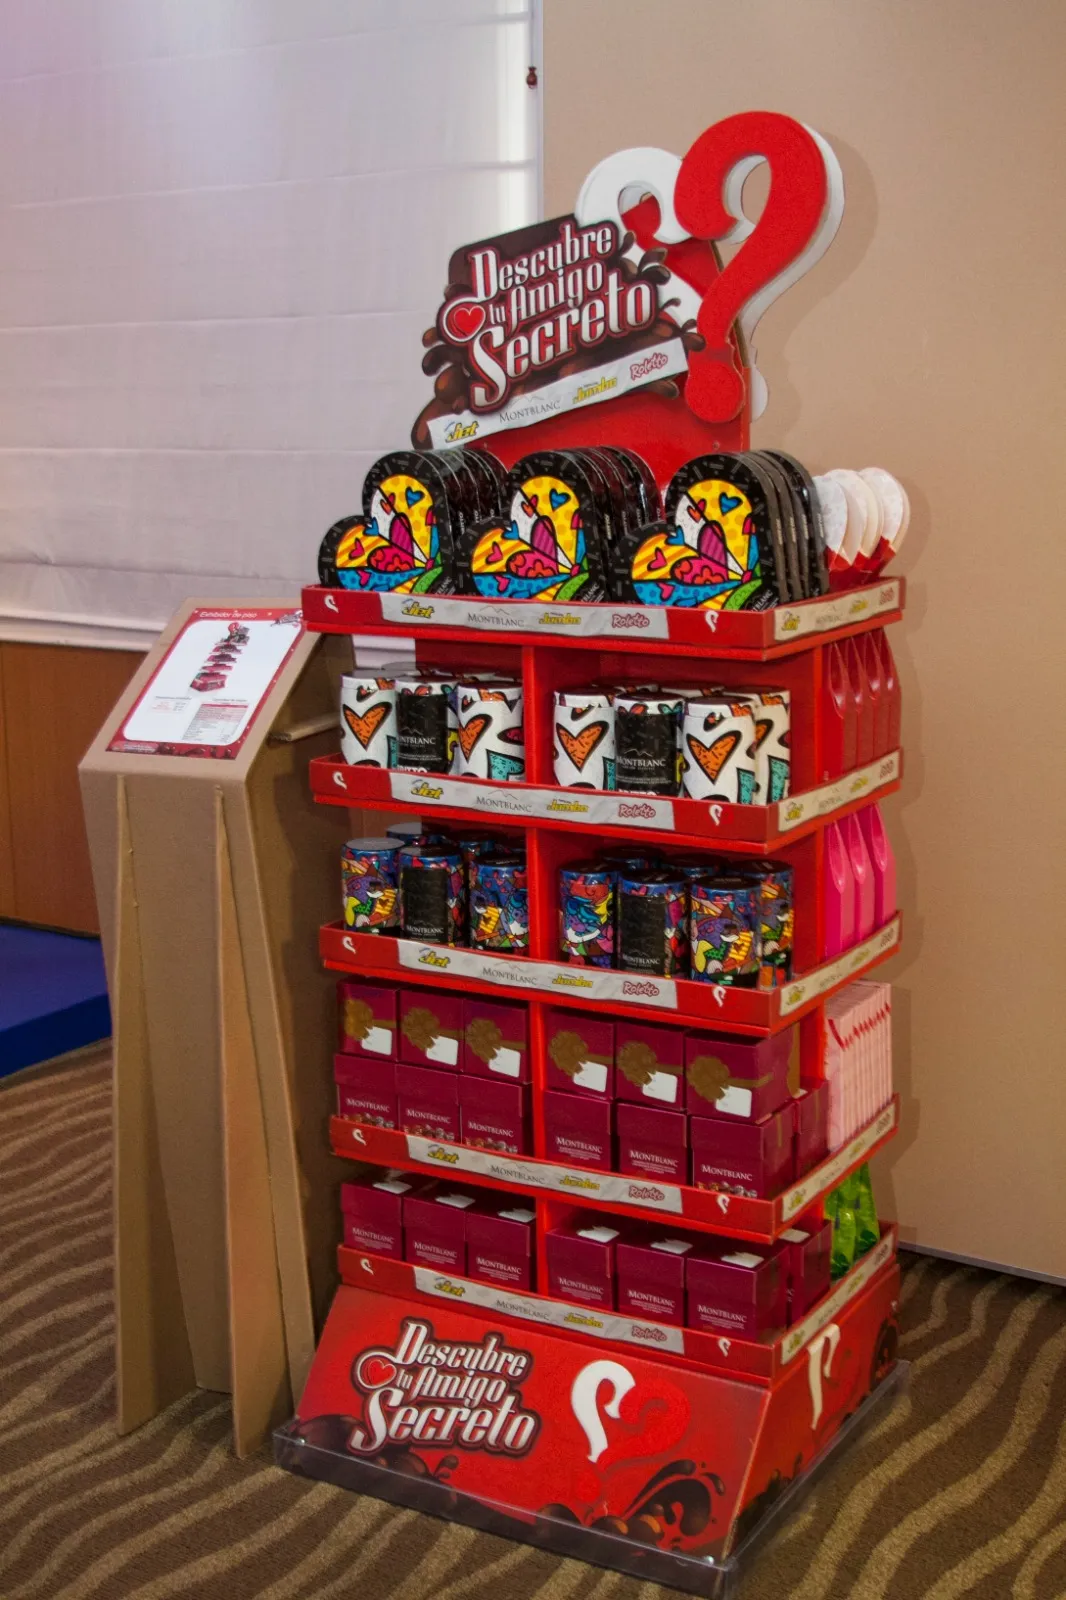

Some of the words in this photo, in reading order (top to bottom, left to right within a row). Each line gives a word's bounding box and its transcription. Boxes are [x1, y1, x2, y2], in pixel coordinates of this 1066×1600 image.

[468, 222, 613, 302] Descubre
[489, 300, 507, 325] tu
[508, 262, 602, 334] Amigo
[473, 272, 651, 408] Secreto
[445, 420, 479, 442] Jet
[500, 400, 560, 423] MONTBLANC
[630, 353, 668, 380] Roletto
[402, 602, 435, 619] Jet
[467, 612, 525, 628] MONTBLANC
[611, 612, 650, 629] Roletto
[410, 782, 444, 800] Jet
[476, 796, 532, 813] MONTBLANC
[618, 803, 656, 820] Roletto
[406, 924, 444, 935] MONTBLANC
[482, 967, 538, 985] MONTBLANC
[623, 980, 660, 998] Roletto
[346, 1098, 391, 1113] MONTBLANC
[407, 1109, 451, 1124] MONTBLANC
[468, 1121, 514, 1137] MONTBLANC
[556, 1136, 602, 1154] MONTBLANC
[630, 1150, 678, 1168] MONTBLANC
[490, 1165, 545, 1184] MONTBLANC
[702, 1164, 752, 1181] MONTBLANC
[353, 1227, 395, 1243] MONTBLANC
[414, 1241, 457, 1258] MONTBLANC
[476, 1257, 522, 1274] MONTBLANC
[558, 1277, 604, 1295] MONTBLANC
[628, 1289, 675, 1308] MONTBLANC
[496, 1299, 550, 1320] MONTBLANC
[698, 1304, 747, 1323] MONTBLANC
[399, 1322, 528, 1377] Descubre
[397, 1369, 412, 1389] tu
[410, 1366, 506, 1407] Amigo
[351, 1387, 536, 1451] Secreto
